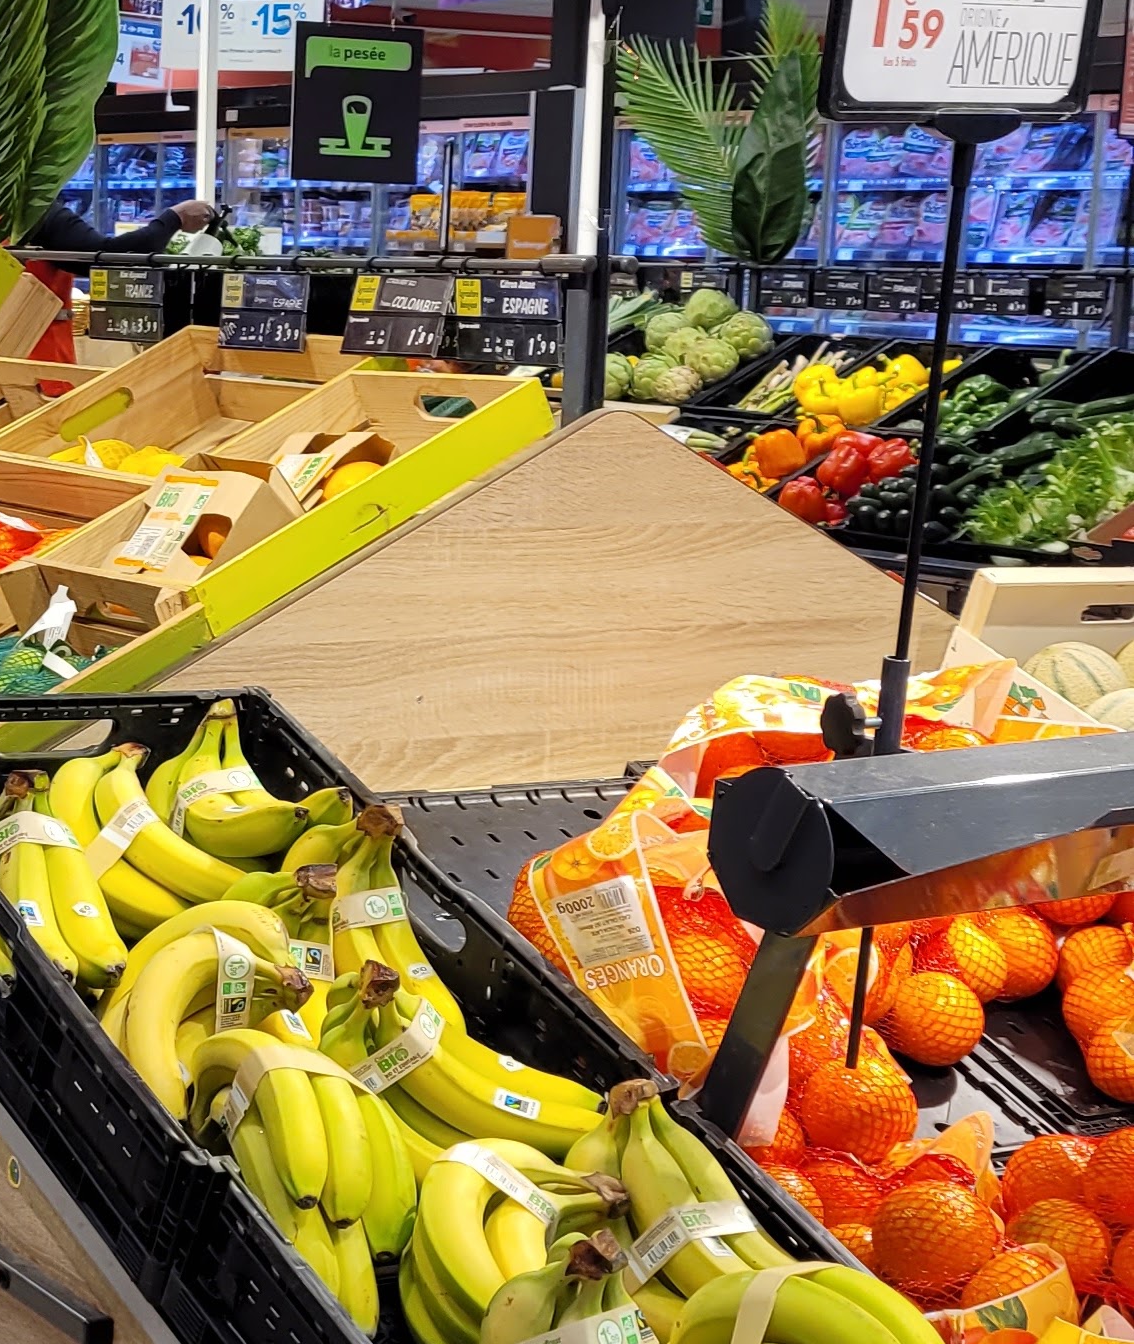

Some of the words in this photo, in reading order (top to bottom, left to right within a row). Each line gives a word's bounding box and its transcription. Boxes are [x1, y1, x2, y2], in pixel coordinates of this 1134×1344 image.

[959, 8, 1003, 27] ORIGINE
[898, 9, 944, 49] 59
[329, 44, 341, 58] la
[344, 46, 386, 61] pesée
[946, 17, 1078, 86] AMÉRIQUE
[502, 297, 549, 315] ESPAGNE
[556, 896, 596, 915] 2000g
[376, 1047, 409, 1074] BIO
[680, 1213, 712, 1228] BIO
